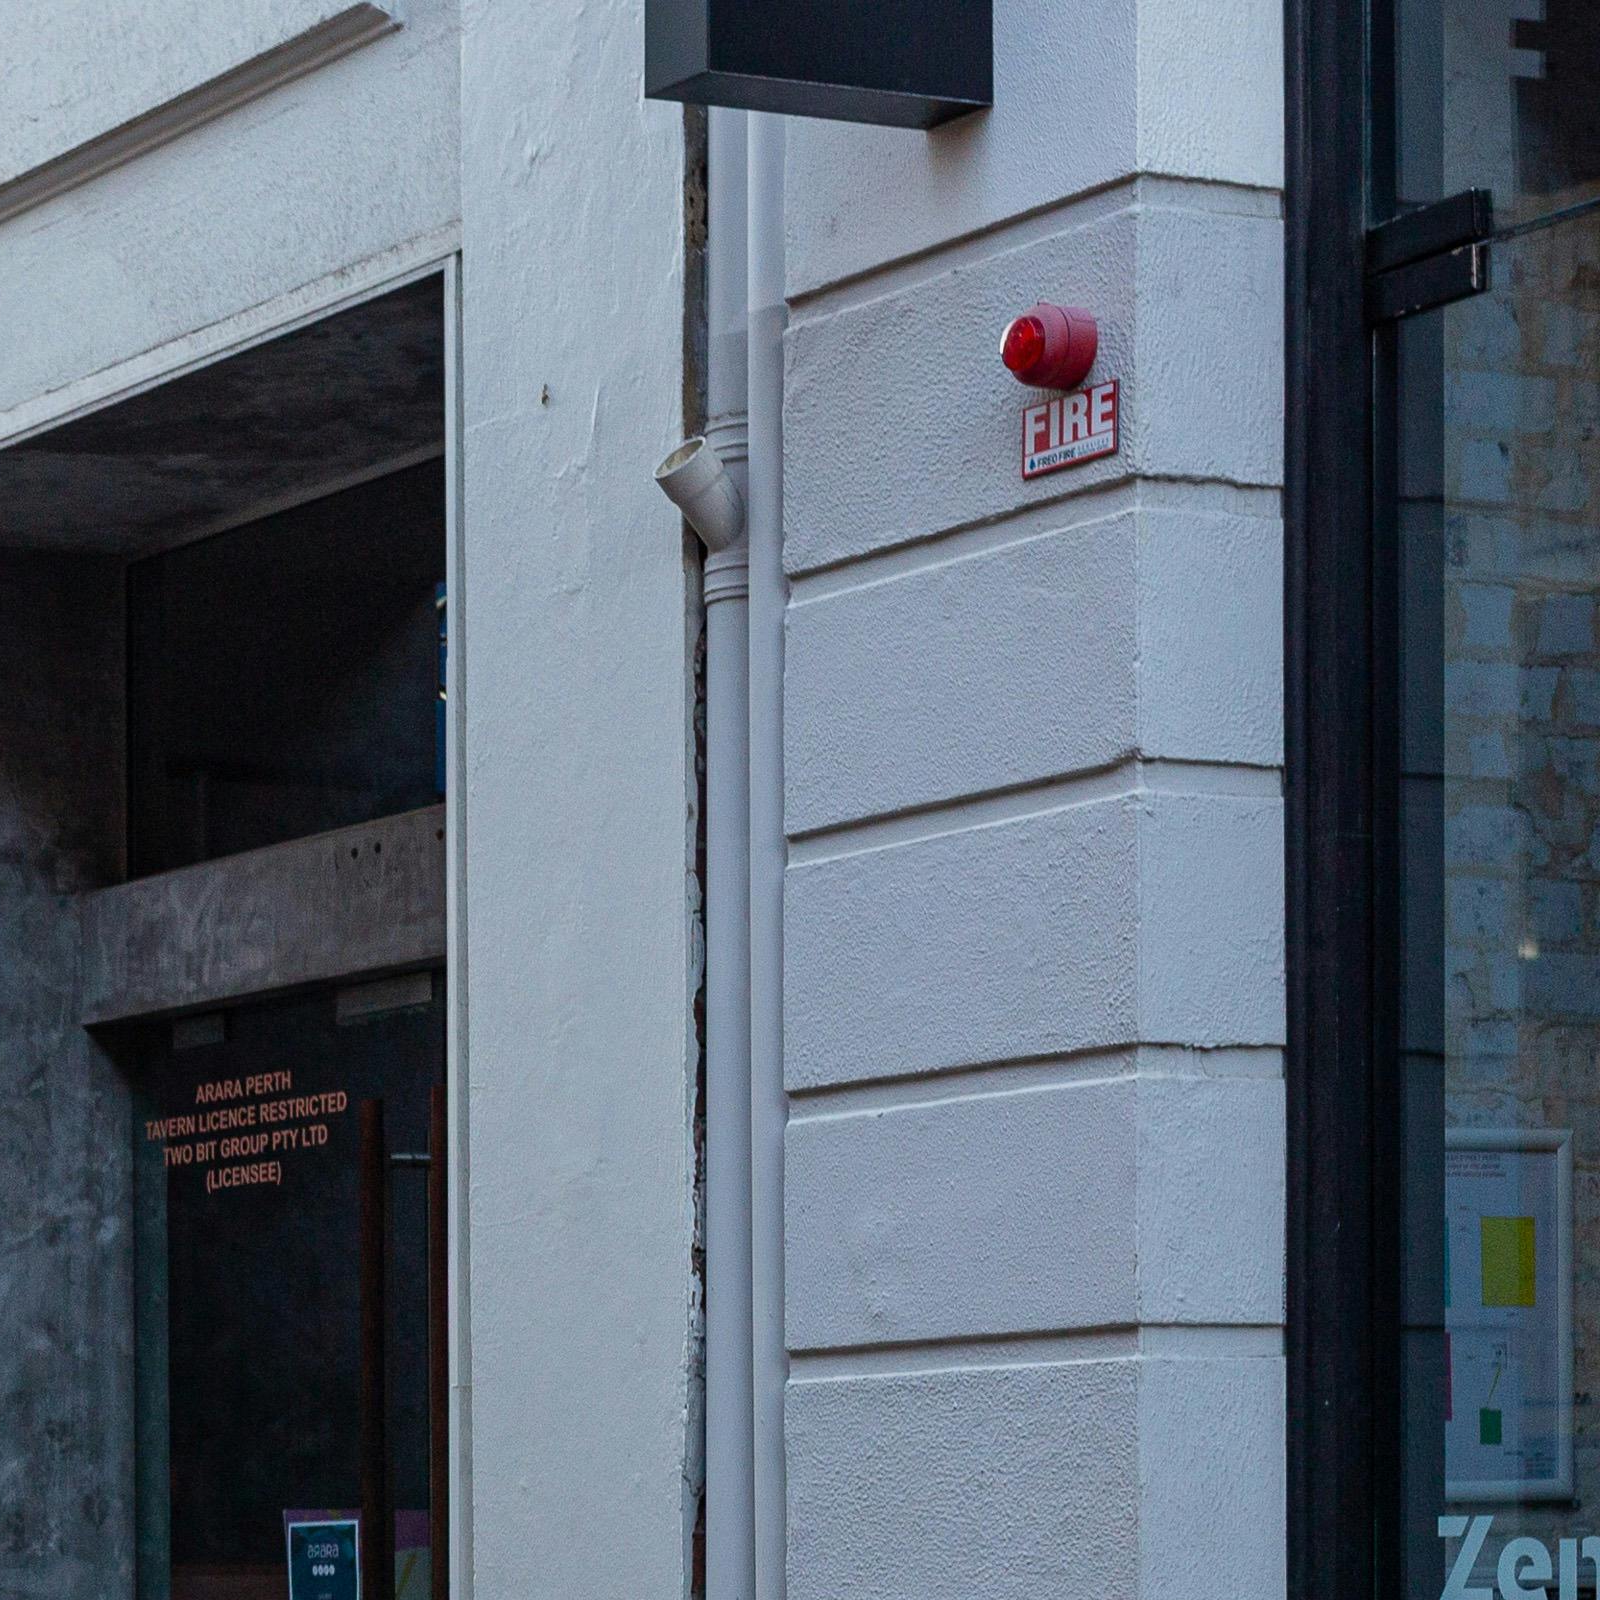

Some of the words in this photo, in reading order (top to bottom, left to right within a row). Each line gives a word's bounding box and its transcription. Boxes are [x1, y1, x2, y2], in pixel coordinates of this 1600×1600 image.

[1025, 381, 1114, 457] FIRE
[196, 1078, 243, 1104] ARARA
[246, 1070, 292, 1097] PERTH
[145, 1113, 196, 1141] TAVERN
[199, 1105, 256, 1133] LICENCE
[260, 1091, 348, 1124] RESTRICTED
[163, 1144, 193, 1167] TWO
[196, 1140, 217, 1162] BIT
[220, 1131, 269, 1160] GROUP
[272, 1128, 298, 1151] PTY
[302, 1124, 329, 1148] LTD
[206, 1161, 282, 1195] (LICENSEE)
